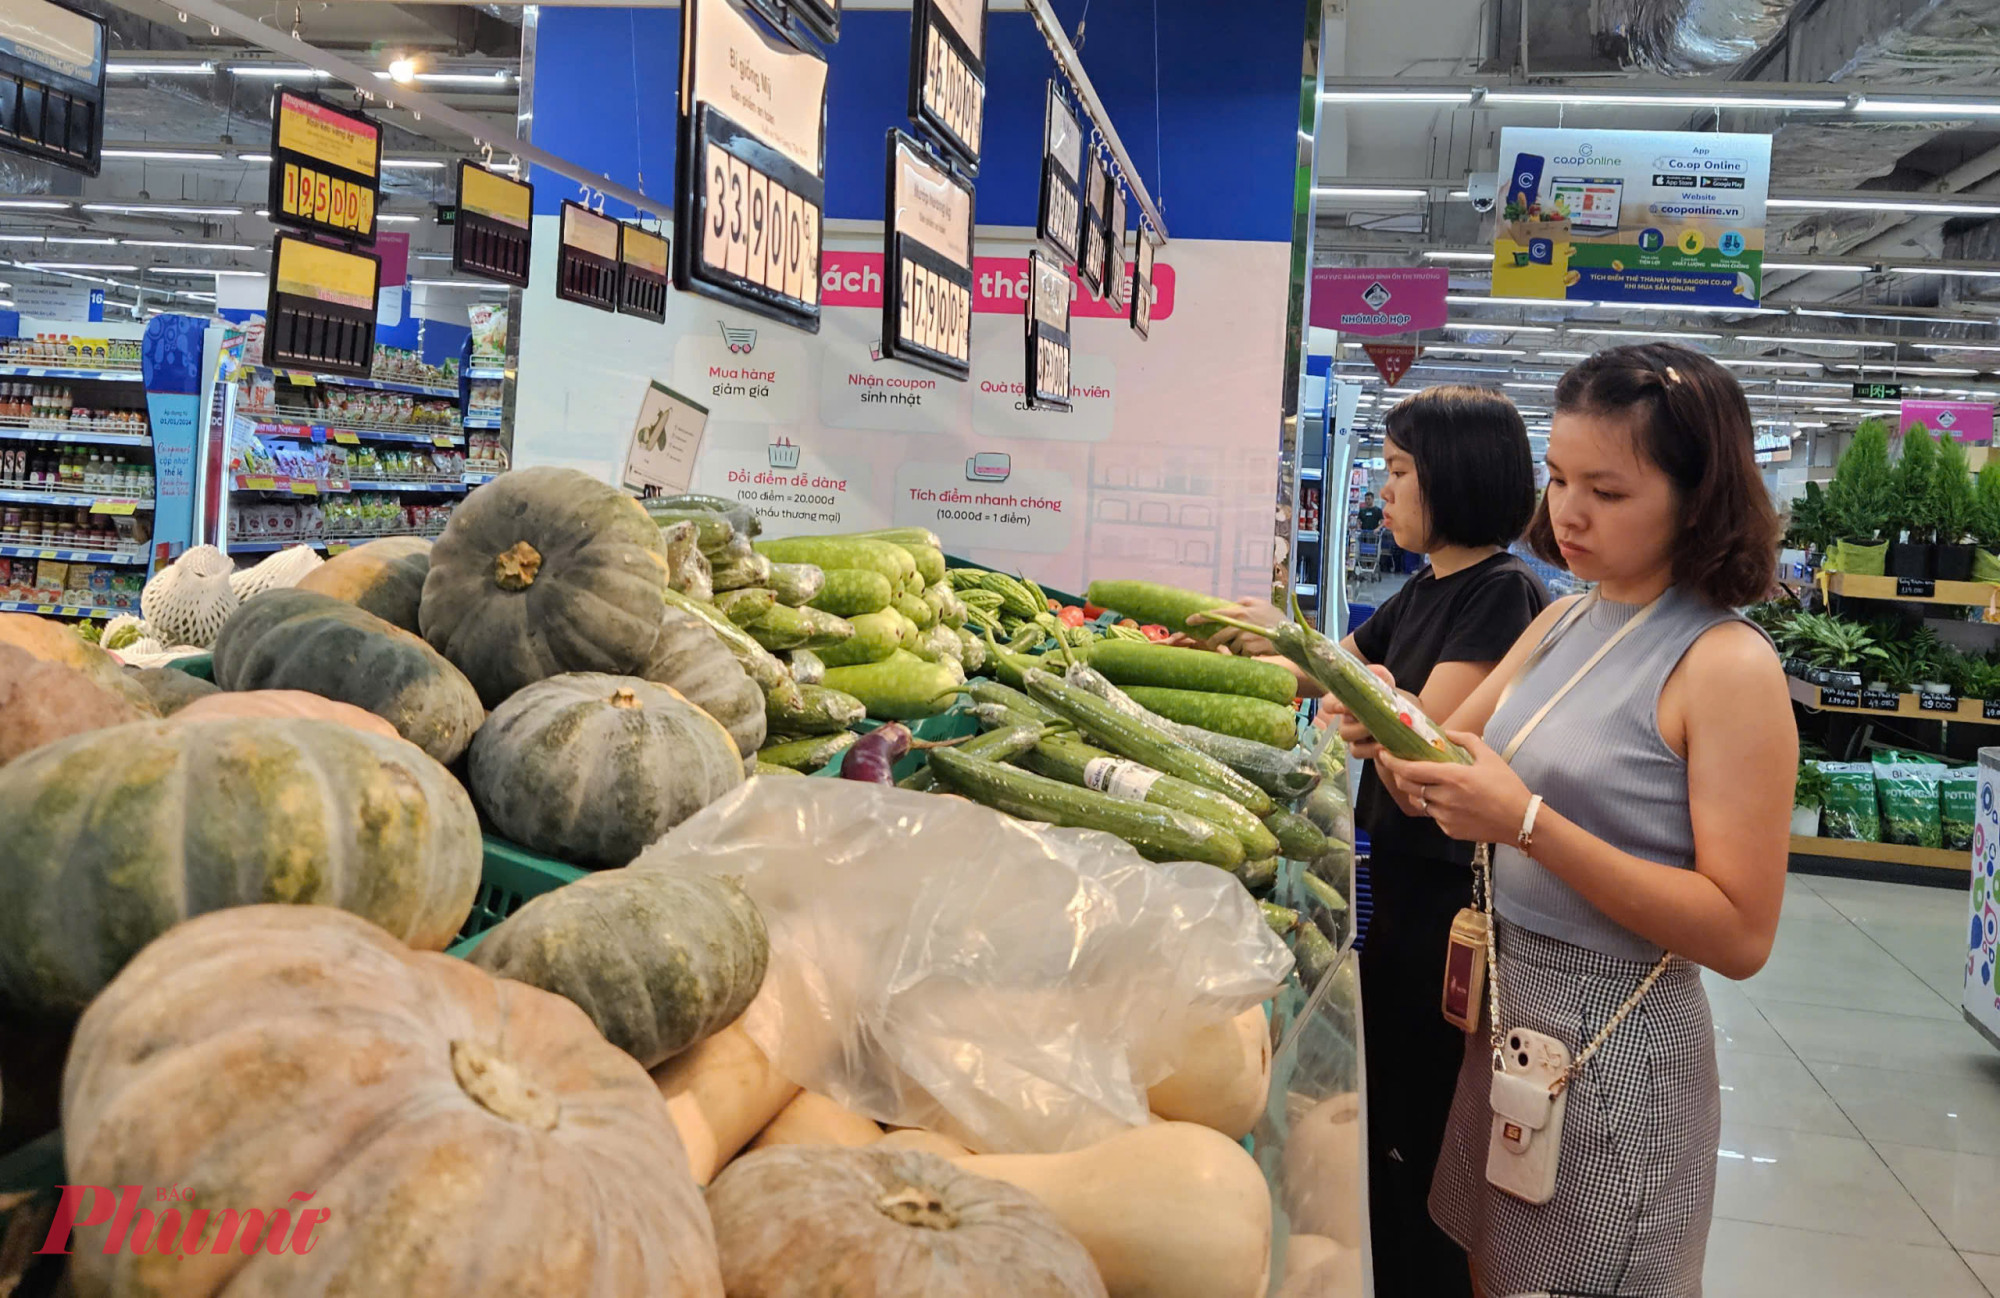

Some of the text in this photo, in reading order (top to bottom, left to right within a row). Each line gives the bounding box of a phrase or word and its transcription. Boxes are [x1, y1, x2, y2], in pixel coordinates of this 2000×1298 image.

[1692, 147, 1710, 155] App
[1669, 160, 1741, 171] Co.op Online
[288, 171, 358, 220] 19.500
[1682, 193, 1717, 201] Website
[1660, 206, 1739, 216] cooponline.vn
[713, 165, 800, 274] 33.900
[1590, 273, 1607, 281] TÍCH
[1640, 275, 1664, 284] THÀNH
[1666, 276, 1682, 284] VIÊN
[1683, 277, 1709, 286] SAIGON
[1710, 279, 1733, 287] CO.OP
[1637, 283, 1654, 291] MUA
[1671, 284, 1696, 292] ONLINE
[91, 293, 104, 305] 16
[901, 271, 958, 338] 47.900
[1341, 311, 1411, 326] NHÓM ĐỒ HỘP
[709, 366, 776, 383] Mua hàng
[848, 373, 936, 391] Nhận coupon
[712, 381, 769, 399] giảm giá
[1083, 385, 1111, 399] viên
[860, 390, 922, 407] sinh nhật
[728, 468, 847, 492] Đổi điểm dễ dàng
[737, 490, 757, 501] (100
[759, 489, 785, 502] điểm
[909, 488, 1062, 513] Tích điểm nhanh chóng
[782, 510, 817, 522] thương
[819, 512, 841, 524] mại)
[936, 509, 982, 521] (10.000đ
[993, 514, 998, 522] 1
[1000, 512, 1031, 527] điểm)
[1945, 791, 1977, 800] POTTIN
